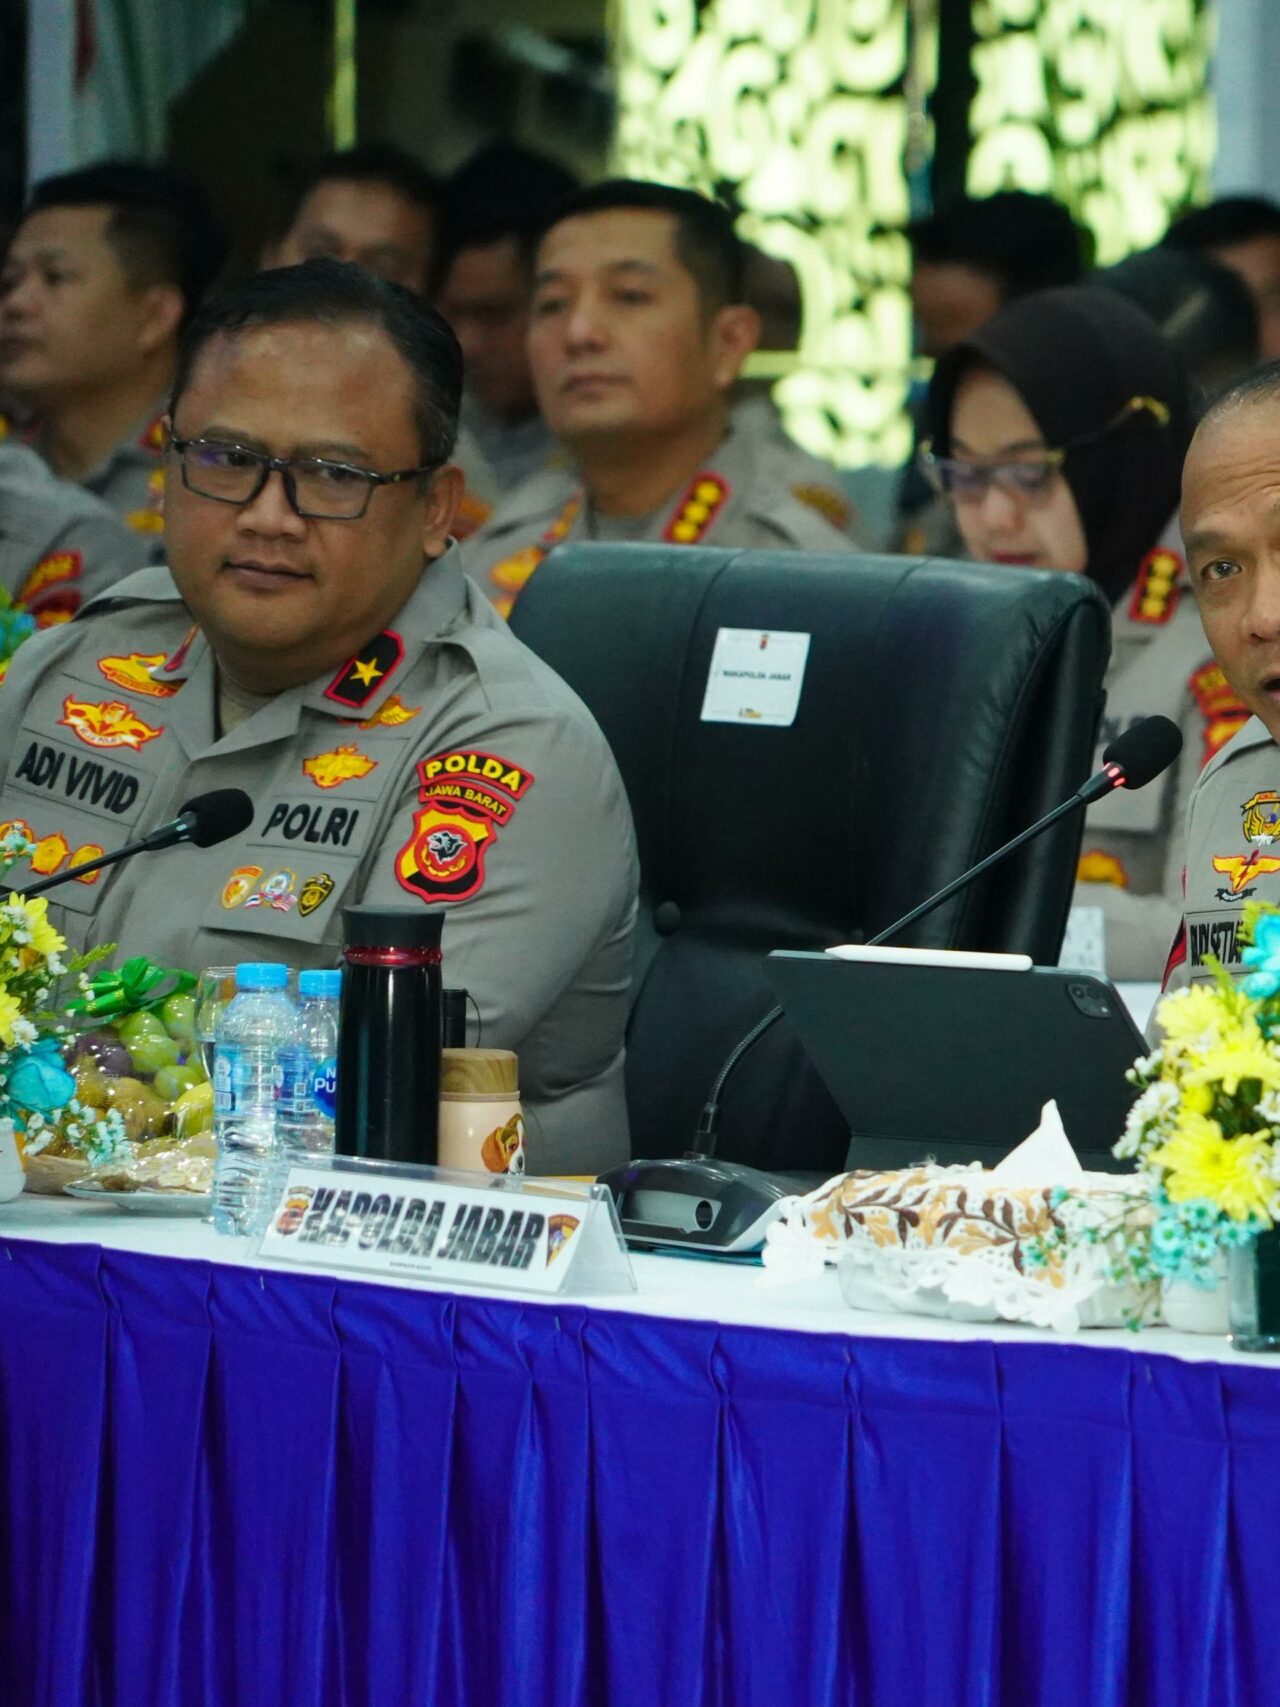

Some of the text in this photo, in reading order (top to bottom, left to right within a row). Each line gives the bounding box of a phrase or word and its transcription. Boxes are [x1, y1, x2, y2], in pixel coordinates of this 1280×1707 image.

[15, 742, 139, 814] ADI VIVID
[425, 753, 521, 792] POLDA
[425, 785, 506, 816] JAWA BARAT
[261, 803, 360, 847] POLRI
[437, 1203, 546, 1270] JABAR
